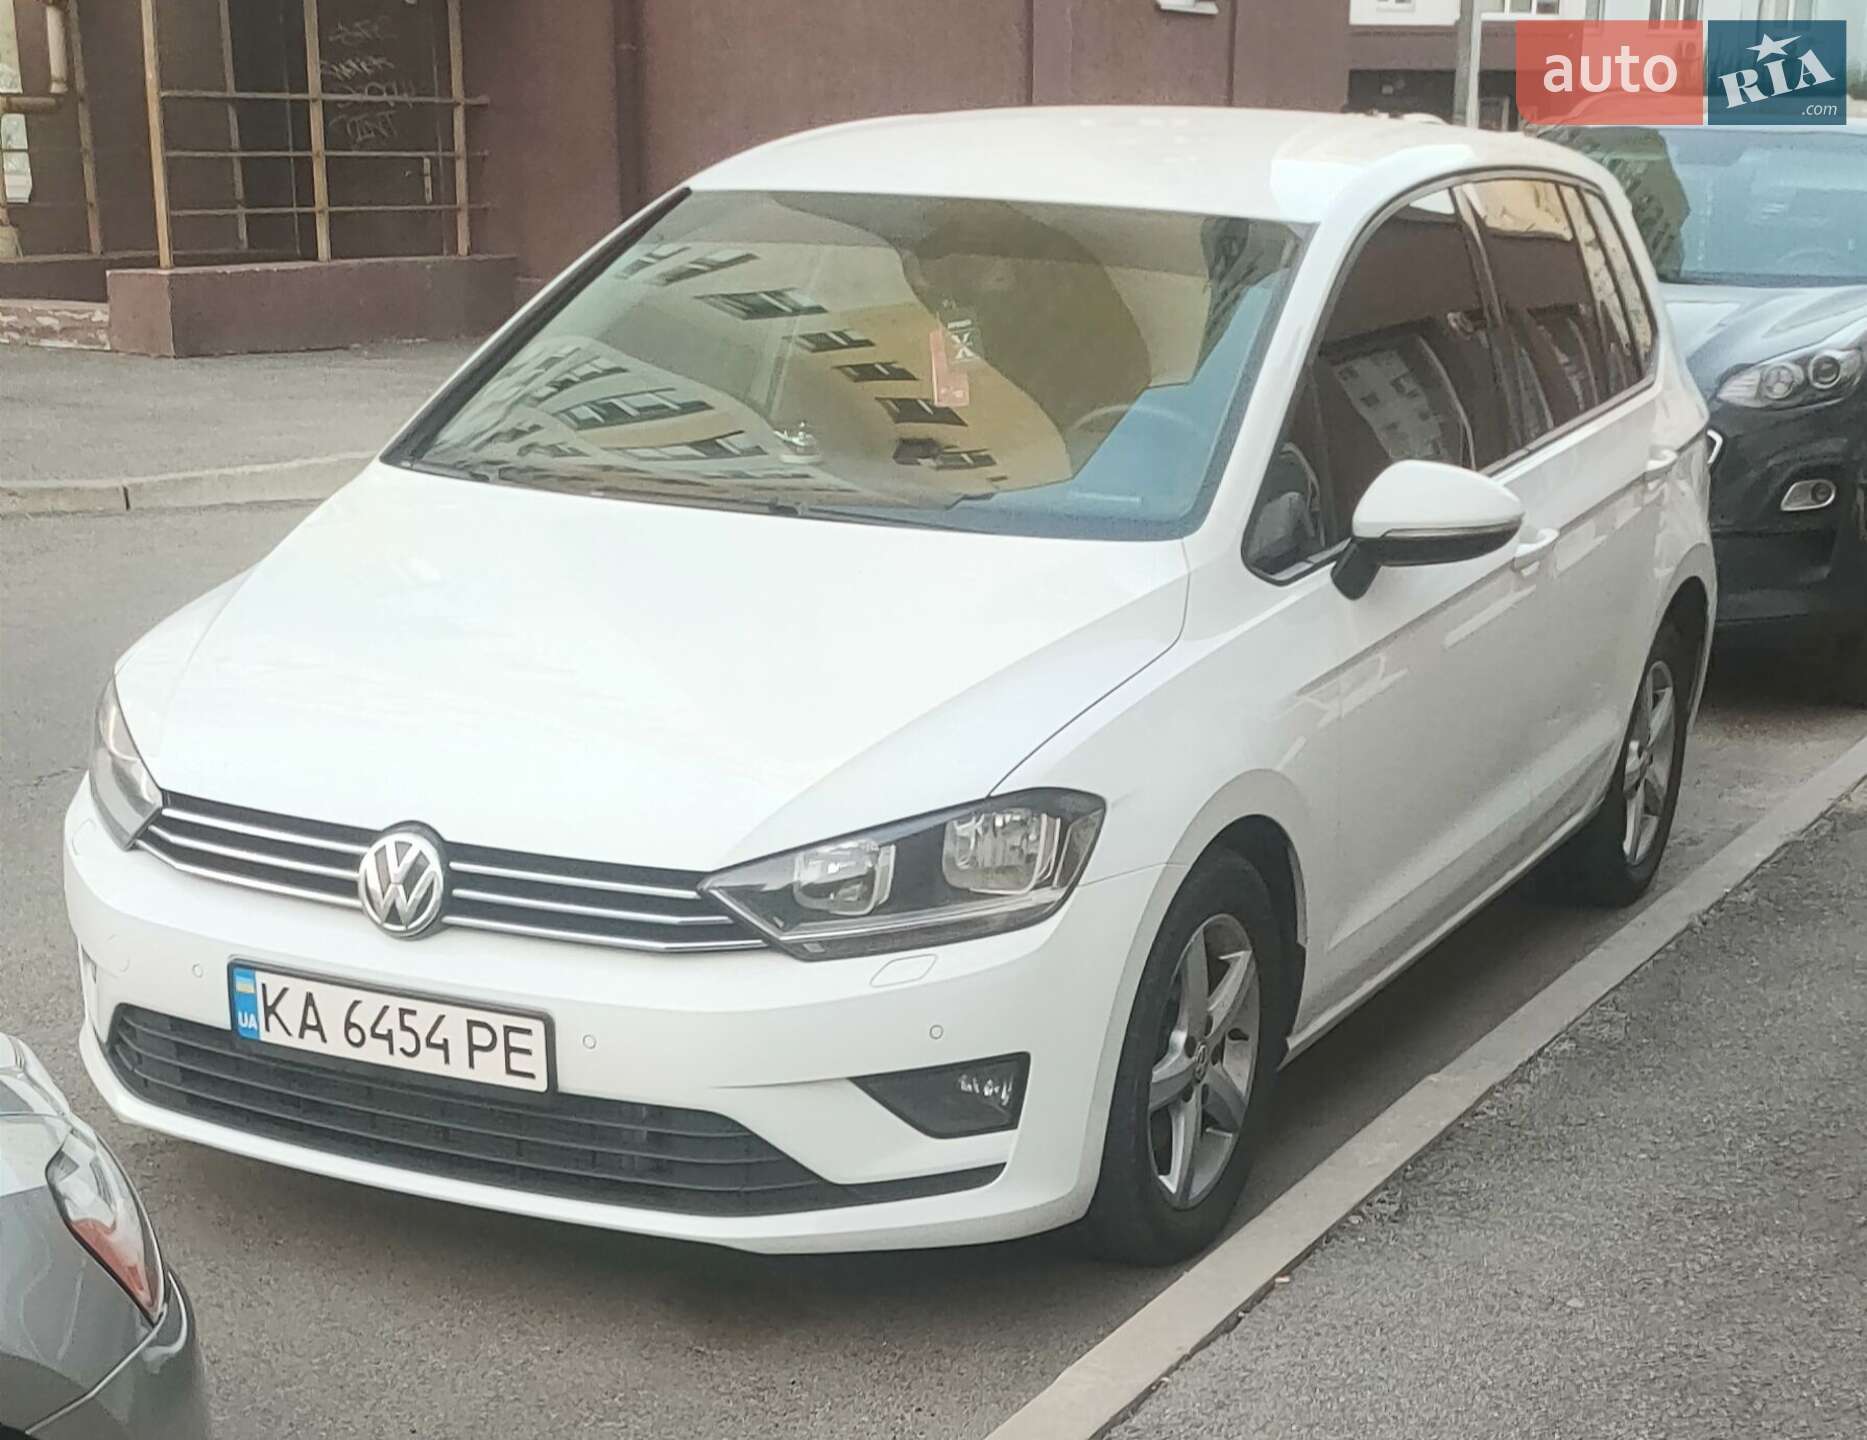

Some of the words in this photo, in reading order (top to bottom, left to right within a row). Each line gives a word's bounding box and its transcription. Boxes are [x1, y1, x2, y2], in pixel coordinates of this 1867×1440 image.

[238, 1011, 258, 1030] UA
[261, 983, 327, 1043] KA
[343, 1000, 450, 1065] 6454
[466, 1019, 536, 1079] PE
